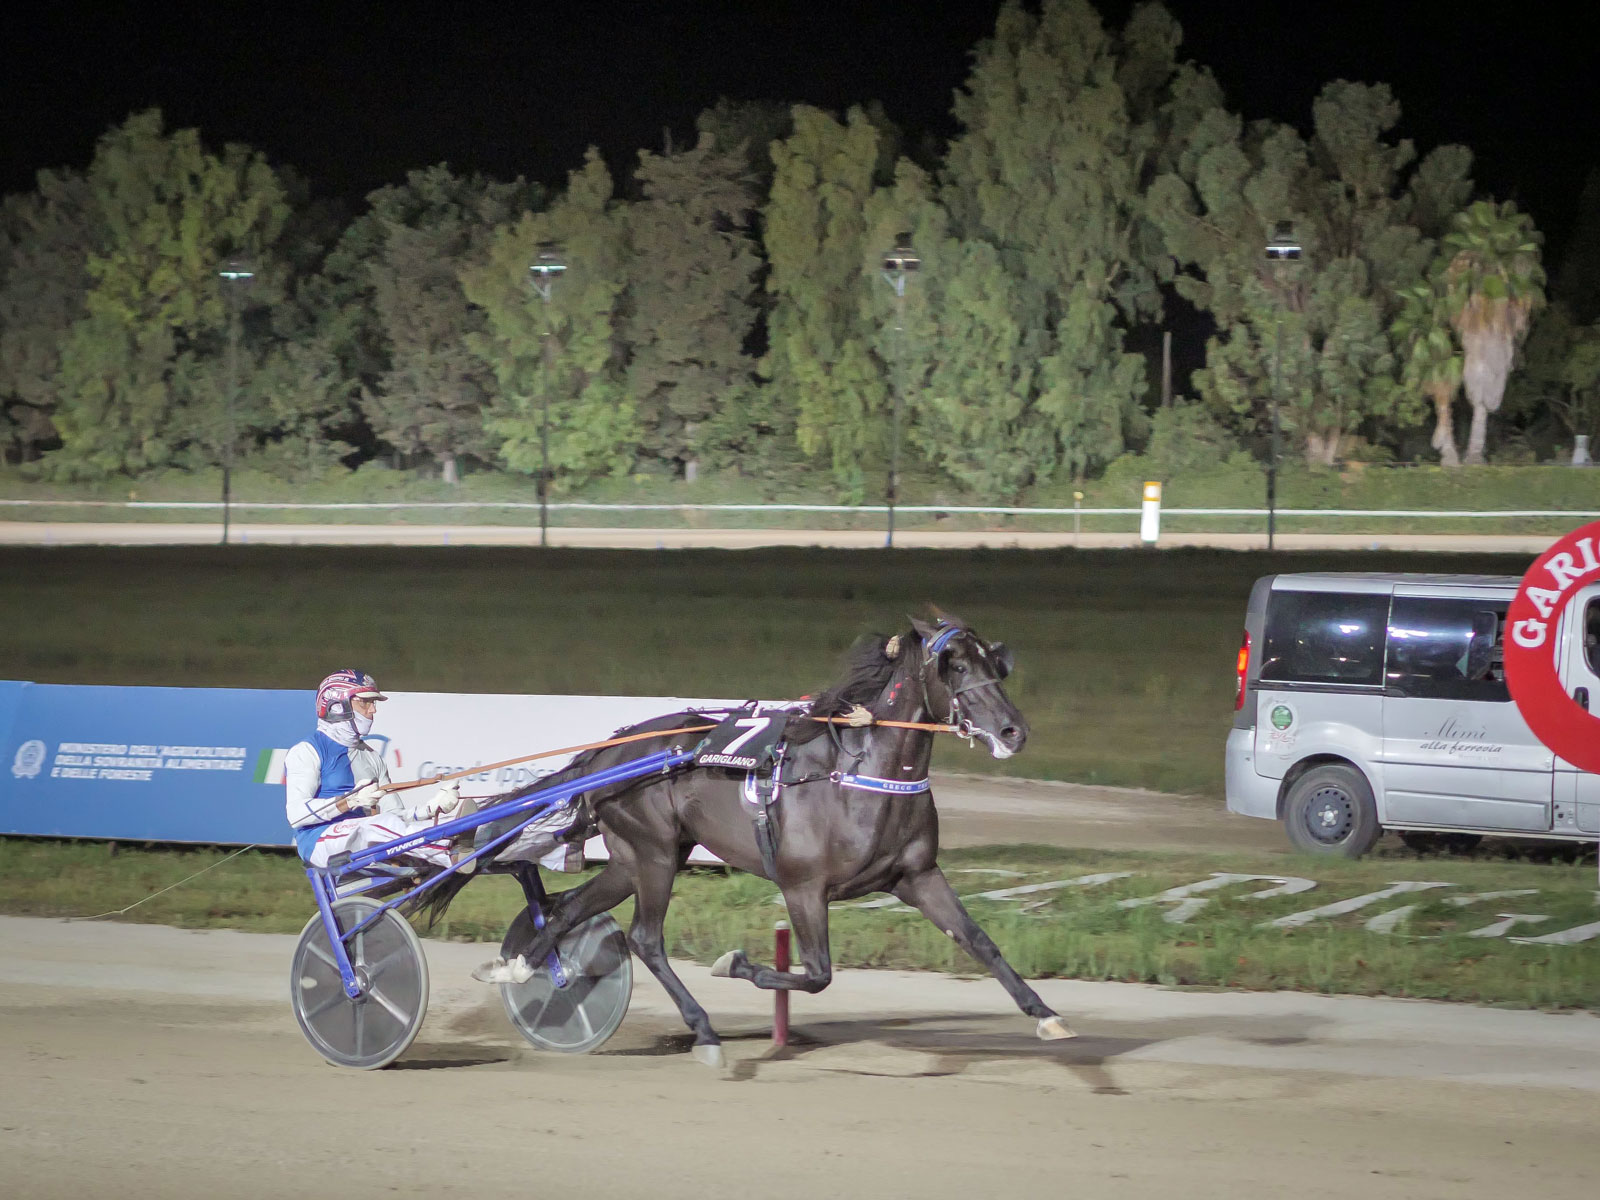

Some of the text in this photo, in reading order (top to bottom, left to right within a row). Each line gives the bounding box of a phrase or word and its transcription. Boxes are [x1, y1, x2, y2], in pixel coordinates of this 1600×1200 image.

[1512, 537, 1600, 648] GARI
[722, 716, 770, 755] 7
[1420, 741, 1447, 750] alla
[699, 752, 757, 767] GARIGLIANO
[50, 767, 61, 778] E
